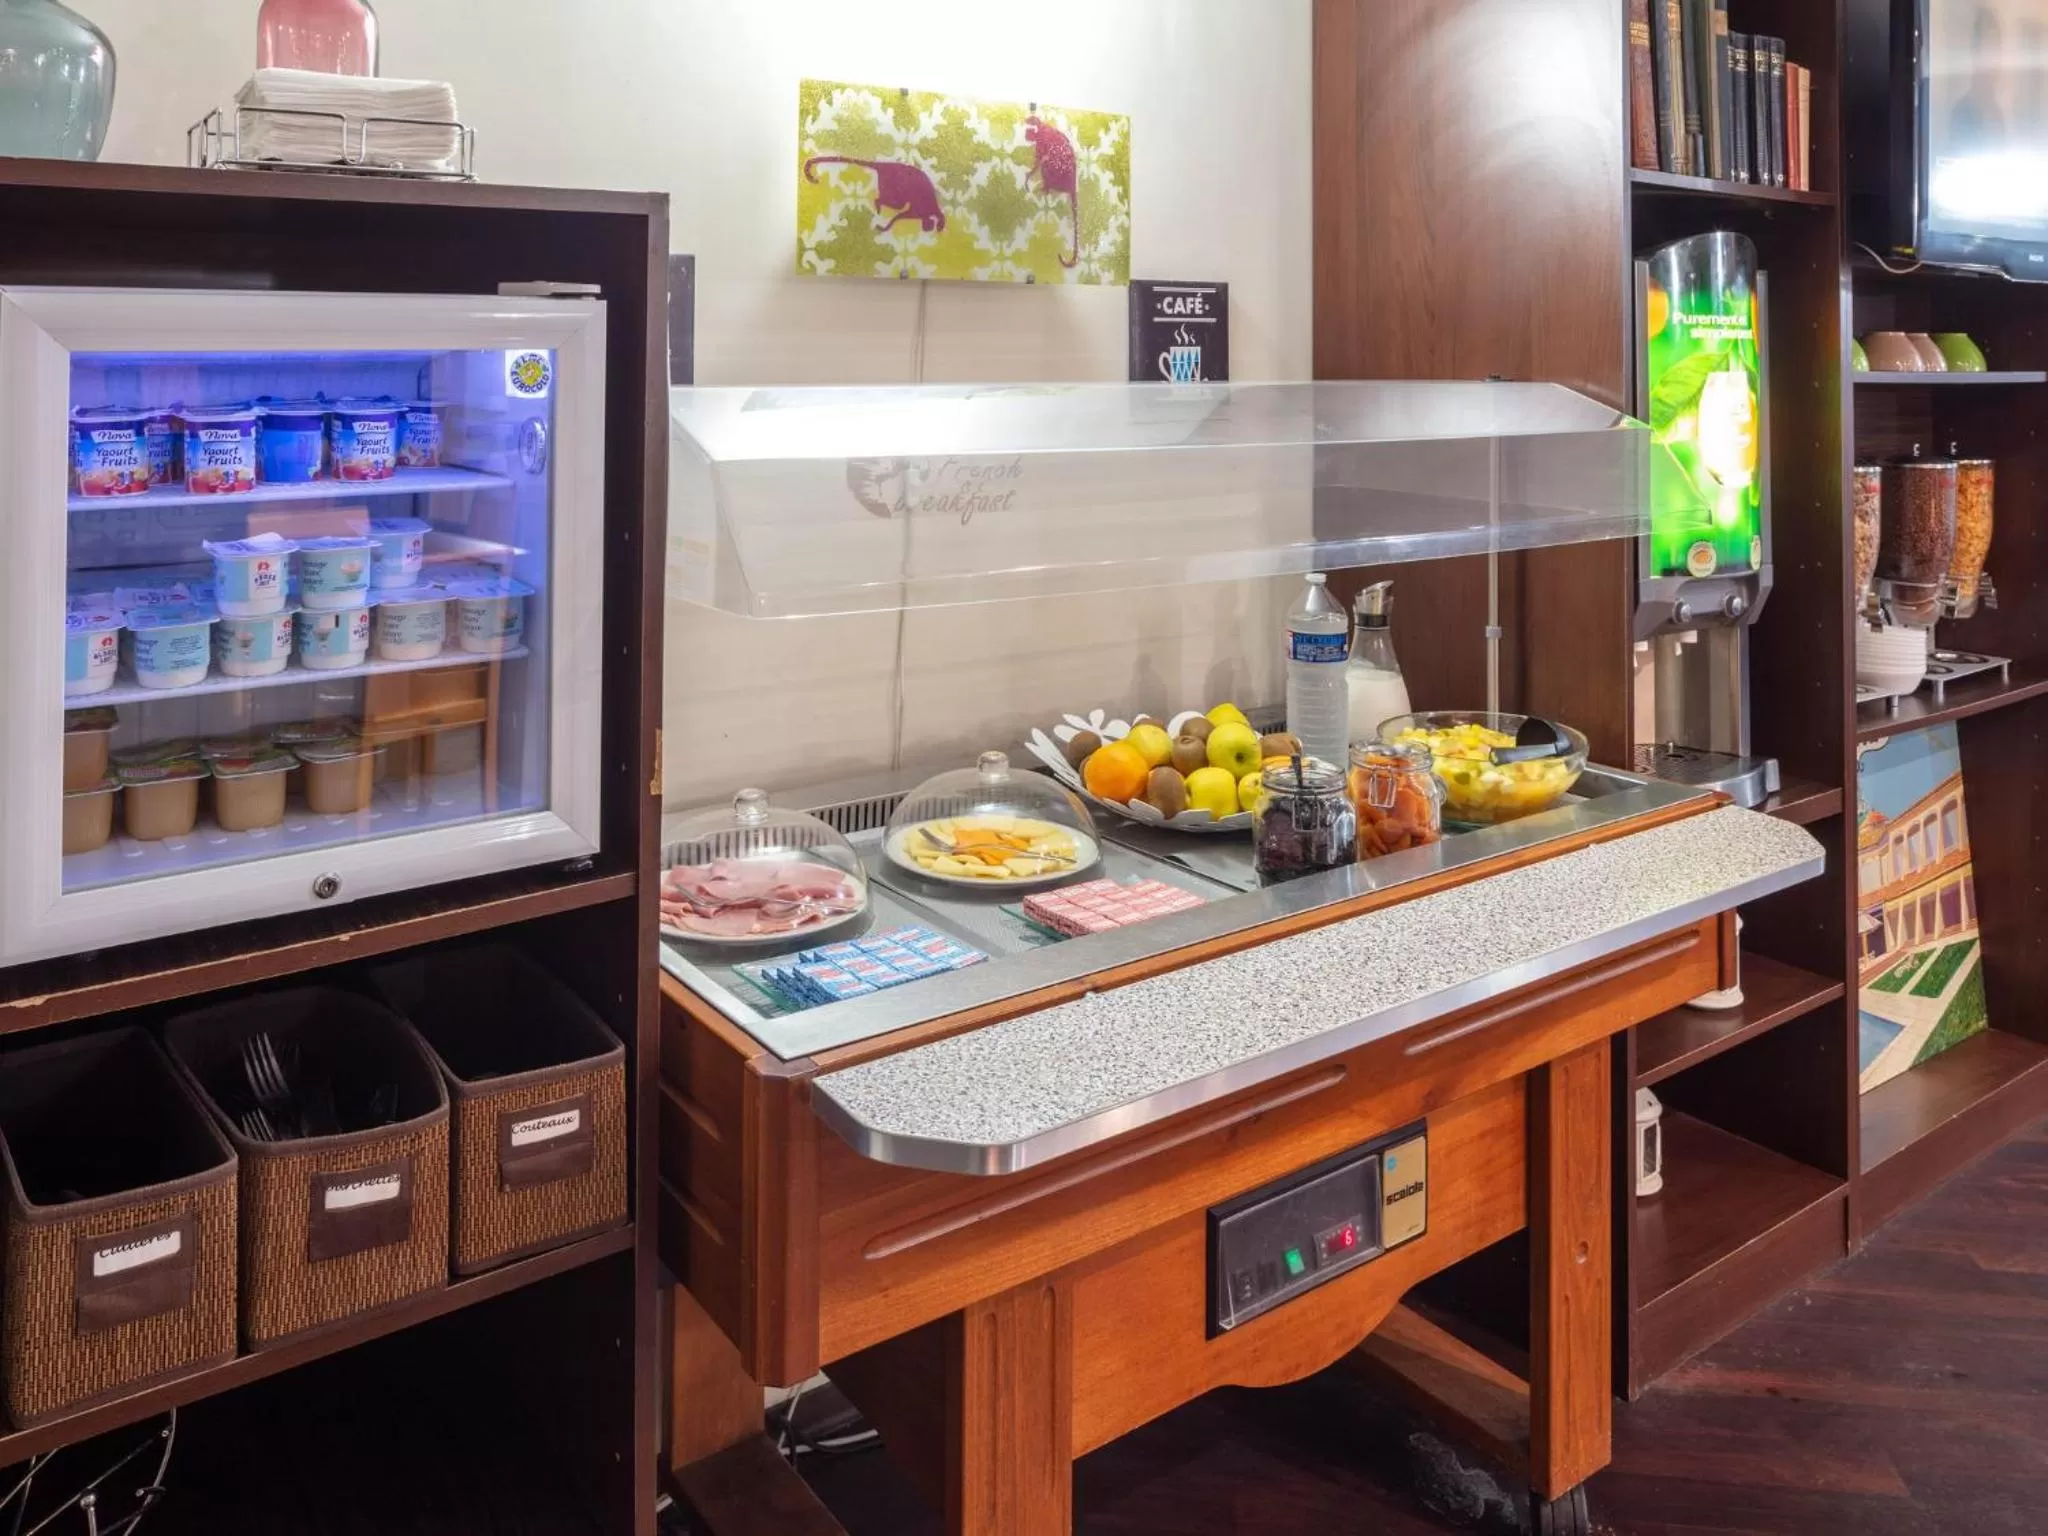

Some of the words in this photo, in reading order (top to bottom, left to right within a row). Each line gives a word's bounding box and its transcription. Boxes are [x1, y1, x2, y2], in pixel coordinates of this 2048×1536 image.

[1163, 292, 1203, 314] CAFÉ
[98, 430, 133, 440] Nova
[205, 430, 238, 440] Nova
[96, 446, 134, 458] Yaourt
[202, 446, 240, 458] Yaourt
[101, 455, 139, 467] Fruits
[207, 455, 243, 466] Fruits
[512, 1116, 575, 1135] Couteaux
